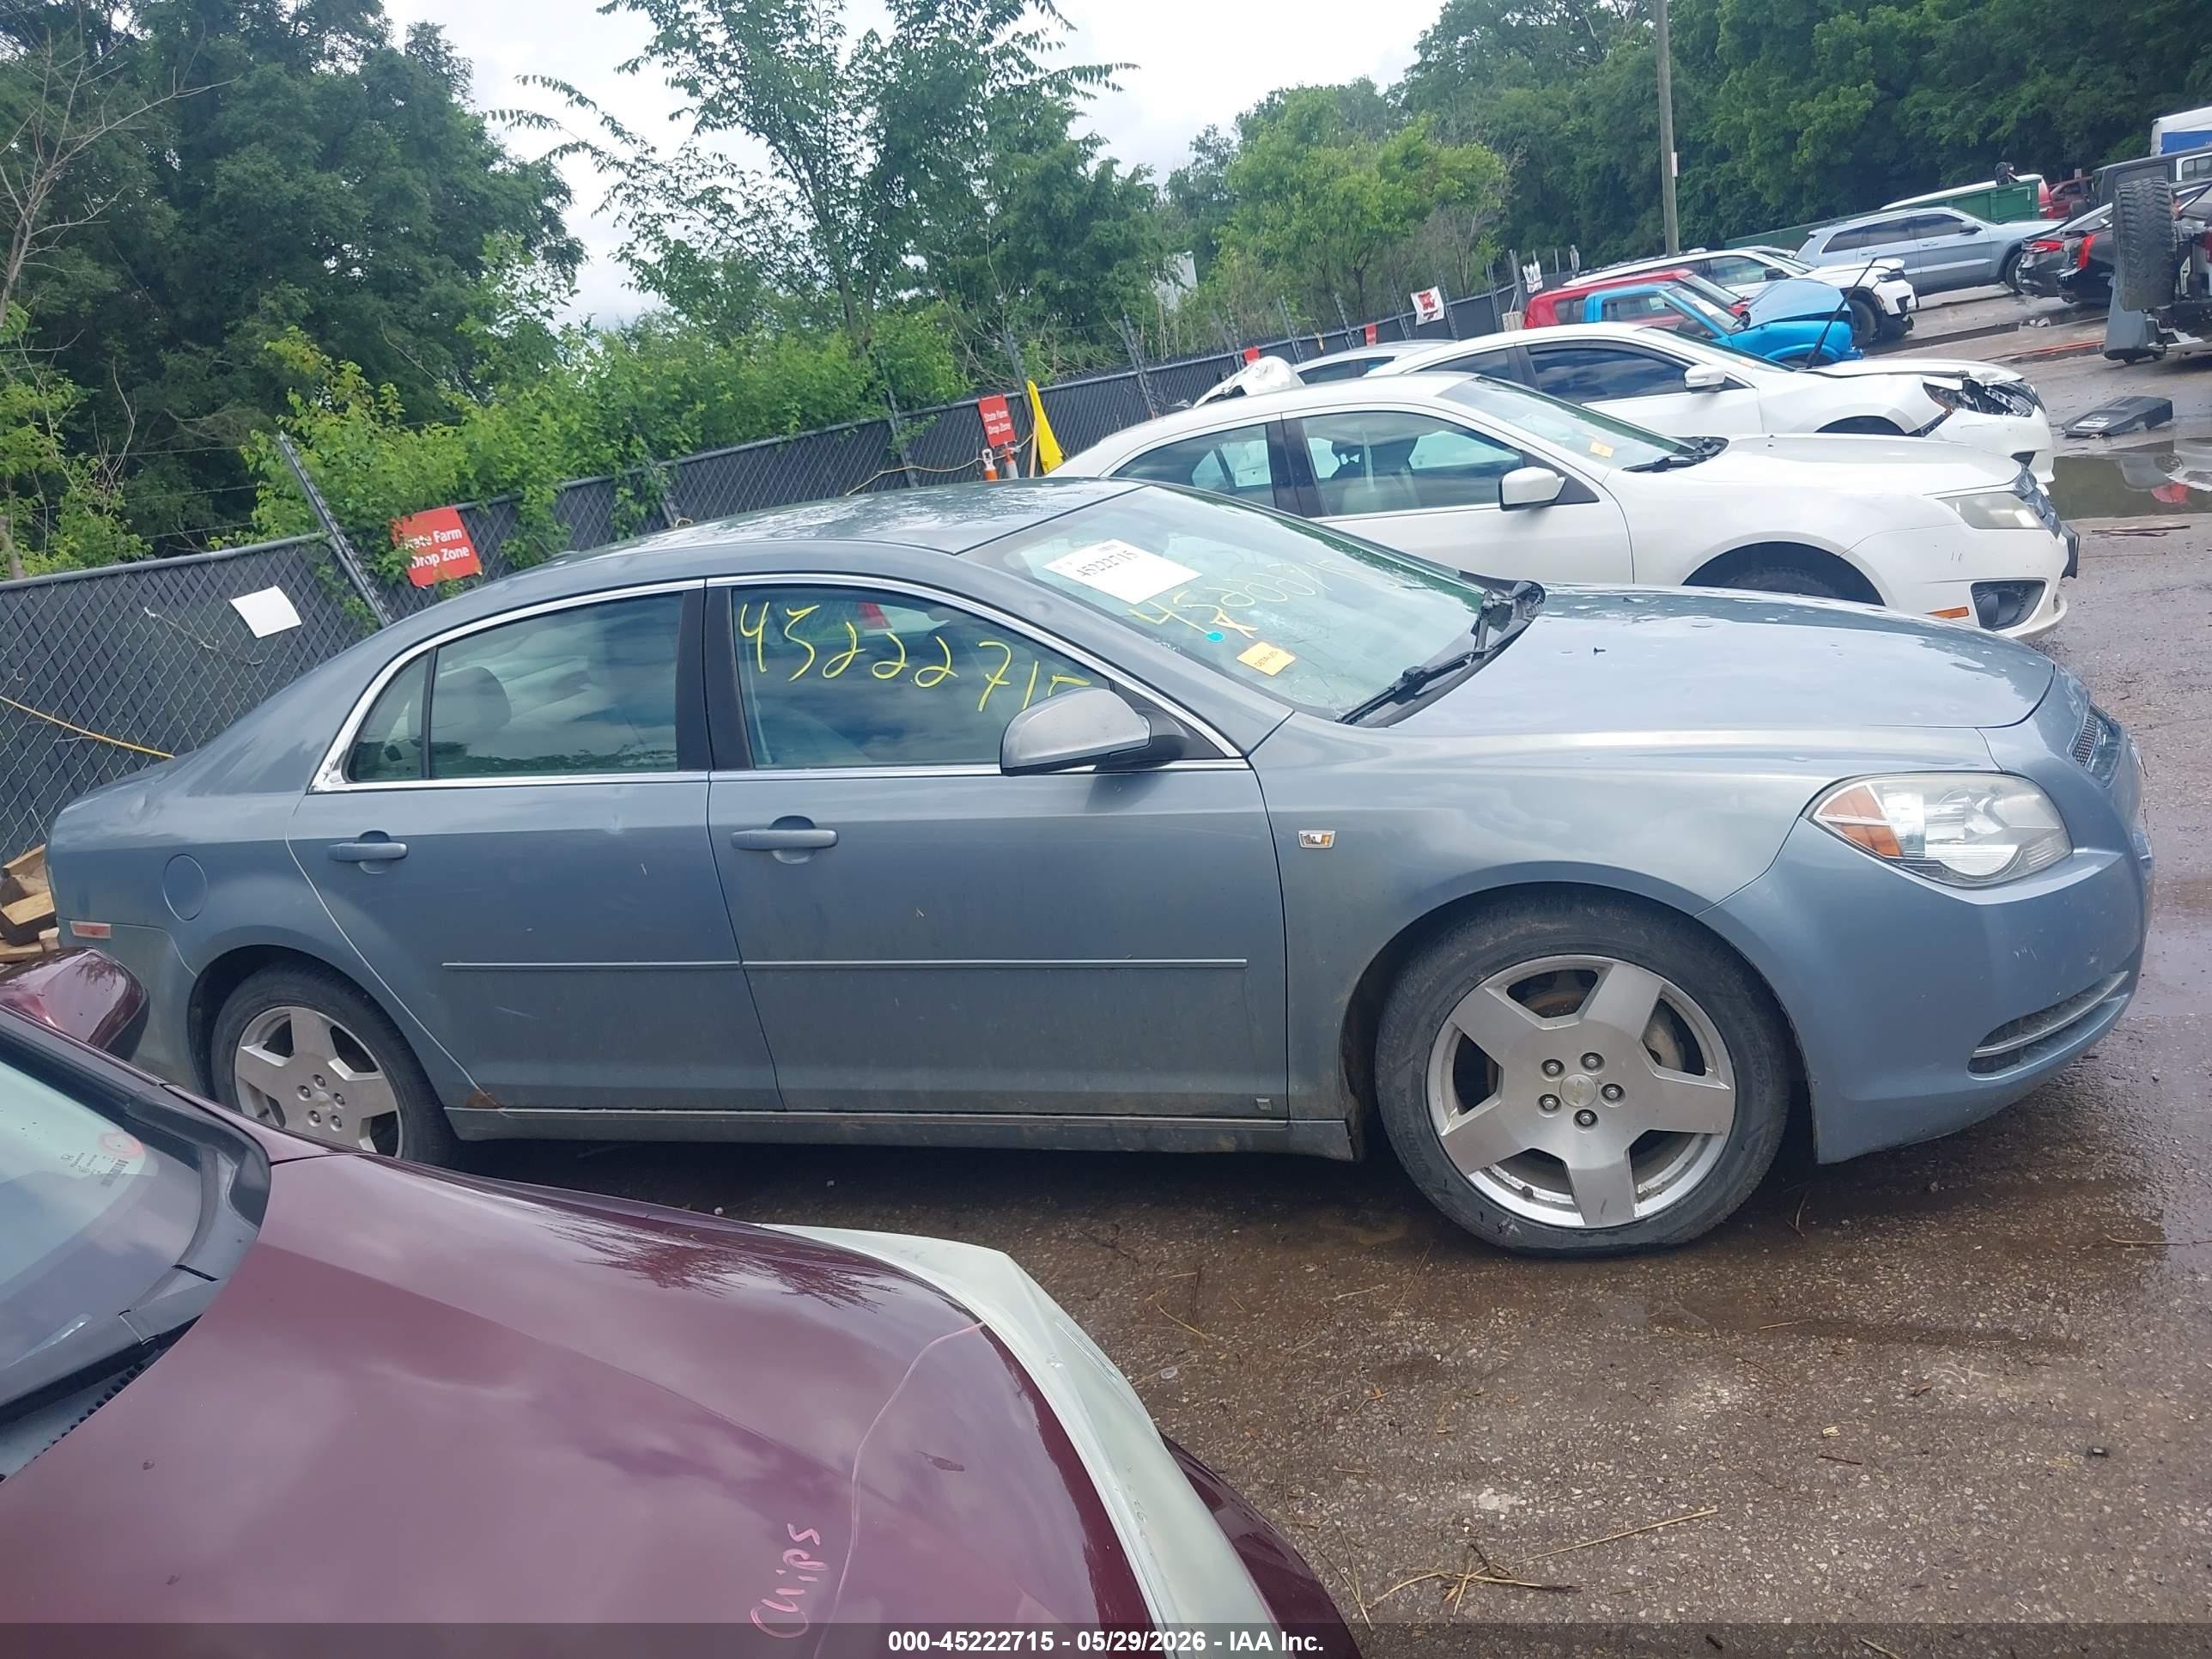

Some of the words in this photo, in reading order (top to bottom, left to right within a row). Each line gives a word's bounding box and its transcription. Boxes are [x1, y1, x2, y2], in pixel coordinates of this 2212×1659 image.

[433, 528, 463, 544] Farm
[411, 553, 441, 568] Drop
[440, 546, 470, 562] Zone
[1076, 550, 1139, 577] 45222715
